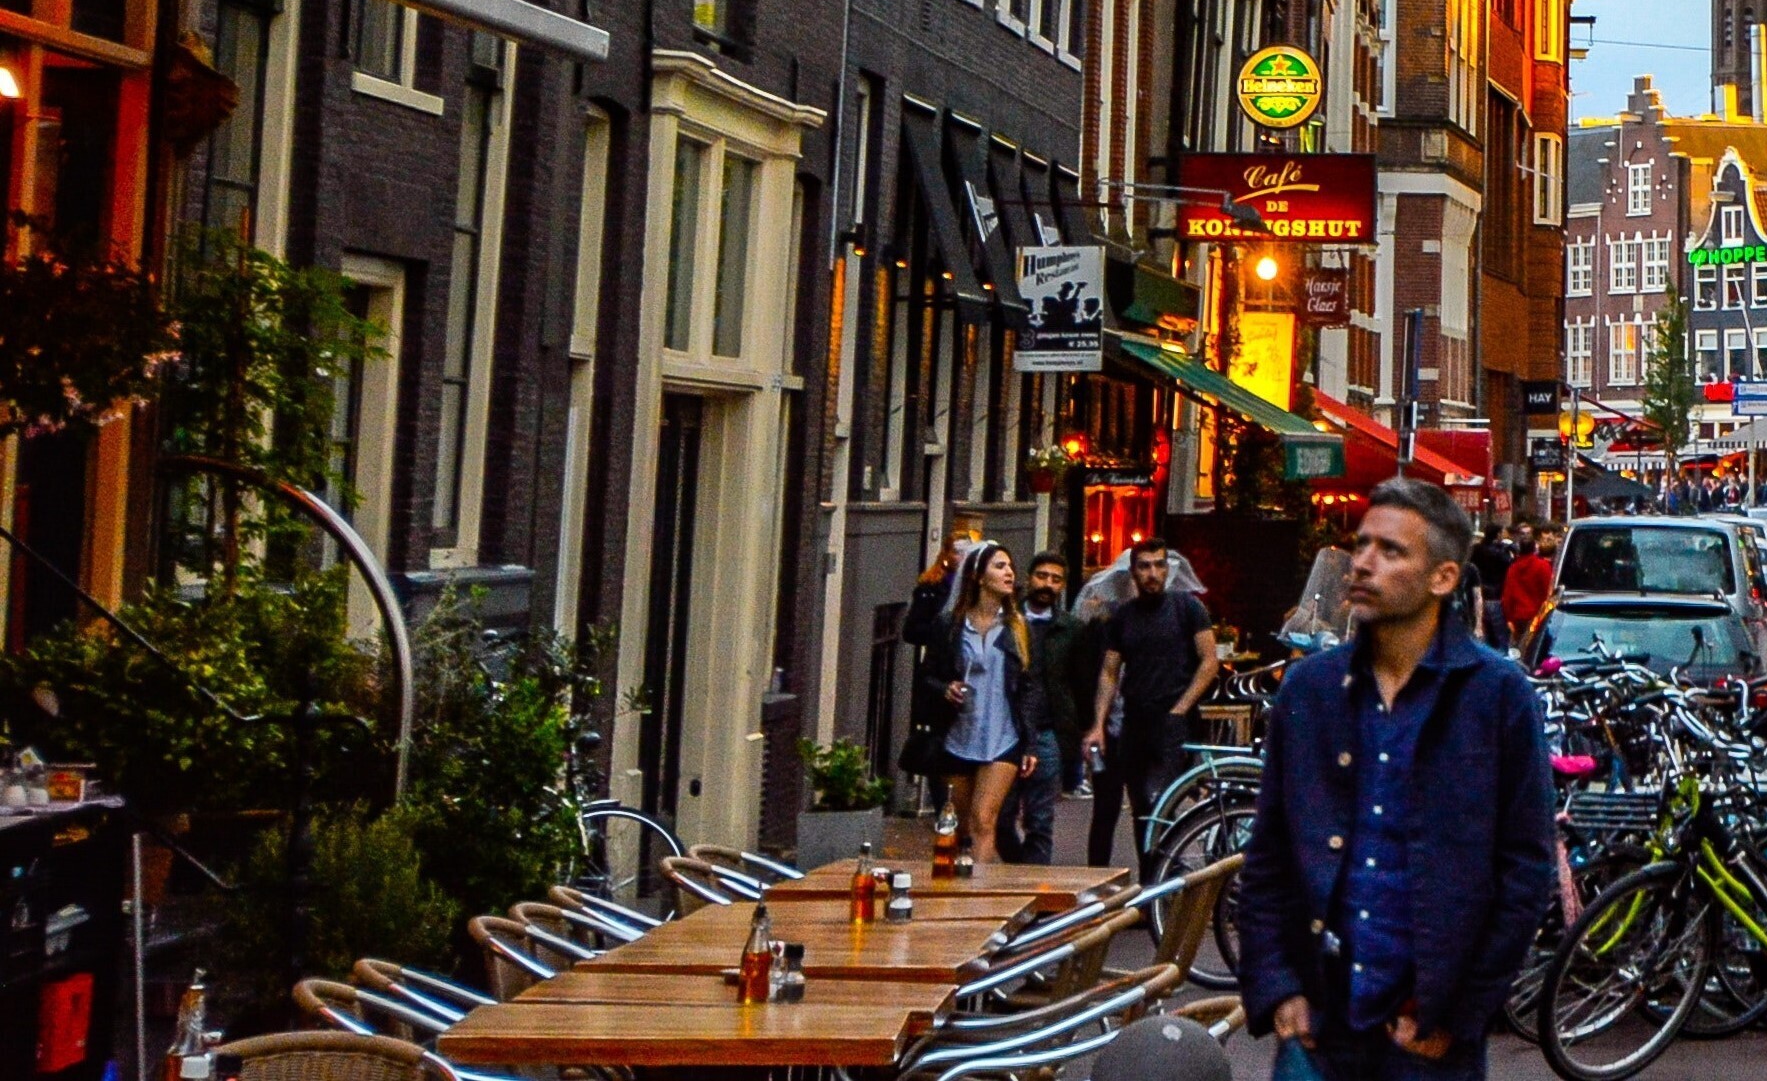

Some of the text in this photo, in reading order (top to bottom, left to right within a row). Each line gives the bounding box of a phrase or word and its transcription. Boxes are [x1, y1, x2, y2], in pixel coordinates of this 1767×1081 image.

[1242, 78, 1315, 93] Heineken
[1243, 160, 1303, 194] Café
[1265, 200, 1289, 213] DE
[1708, 245, 1766, 265] HOPPE
[1528, 392, 1553, 404] HAY
